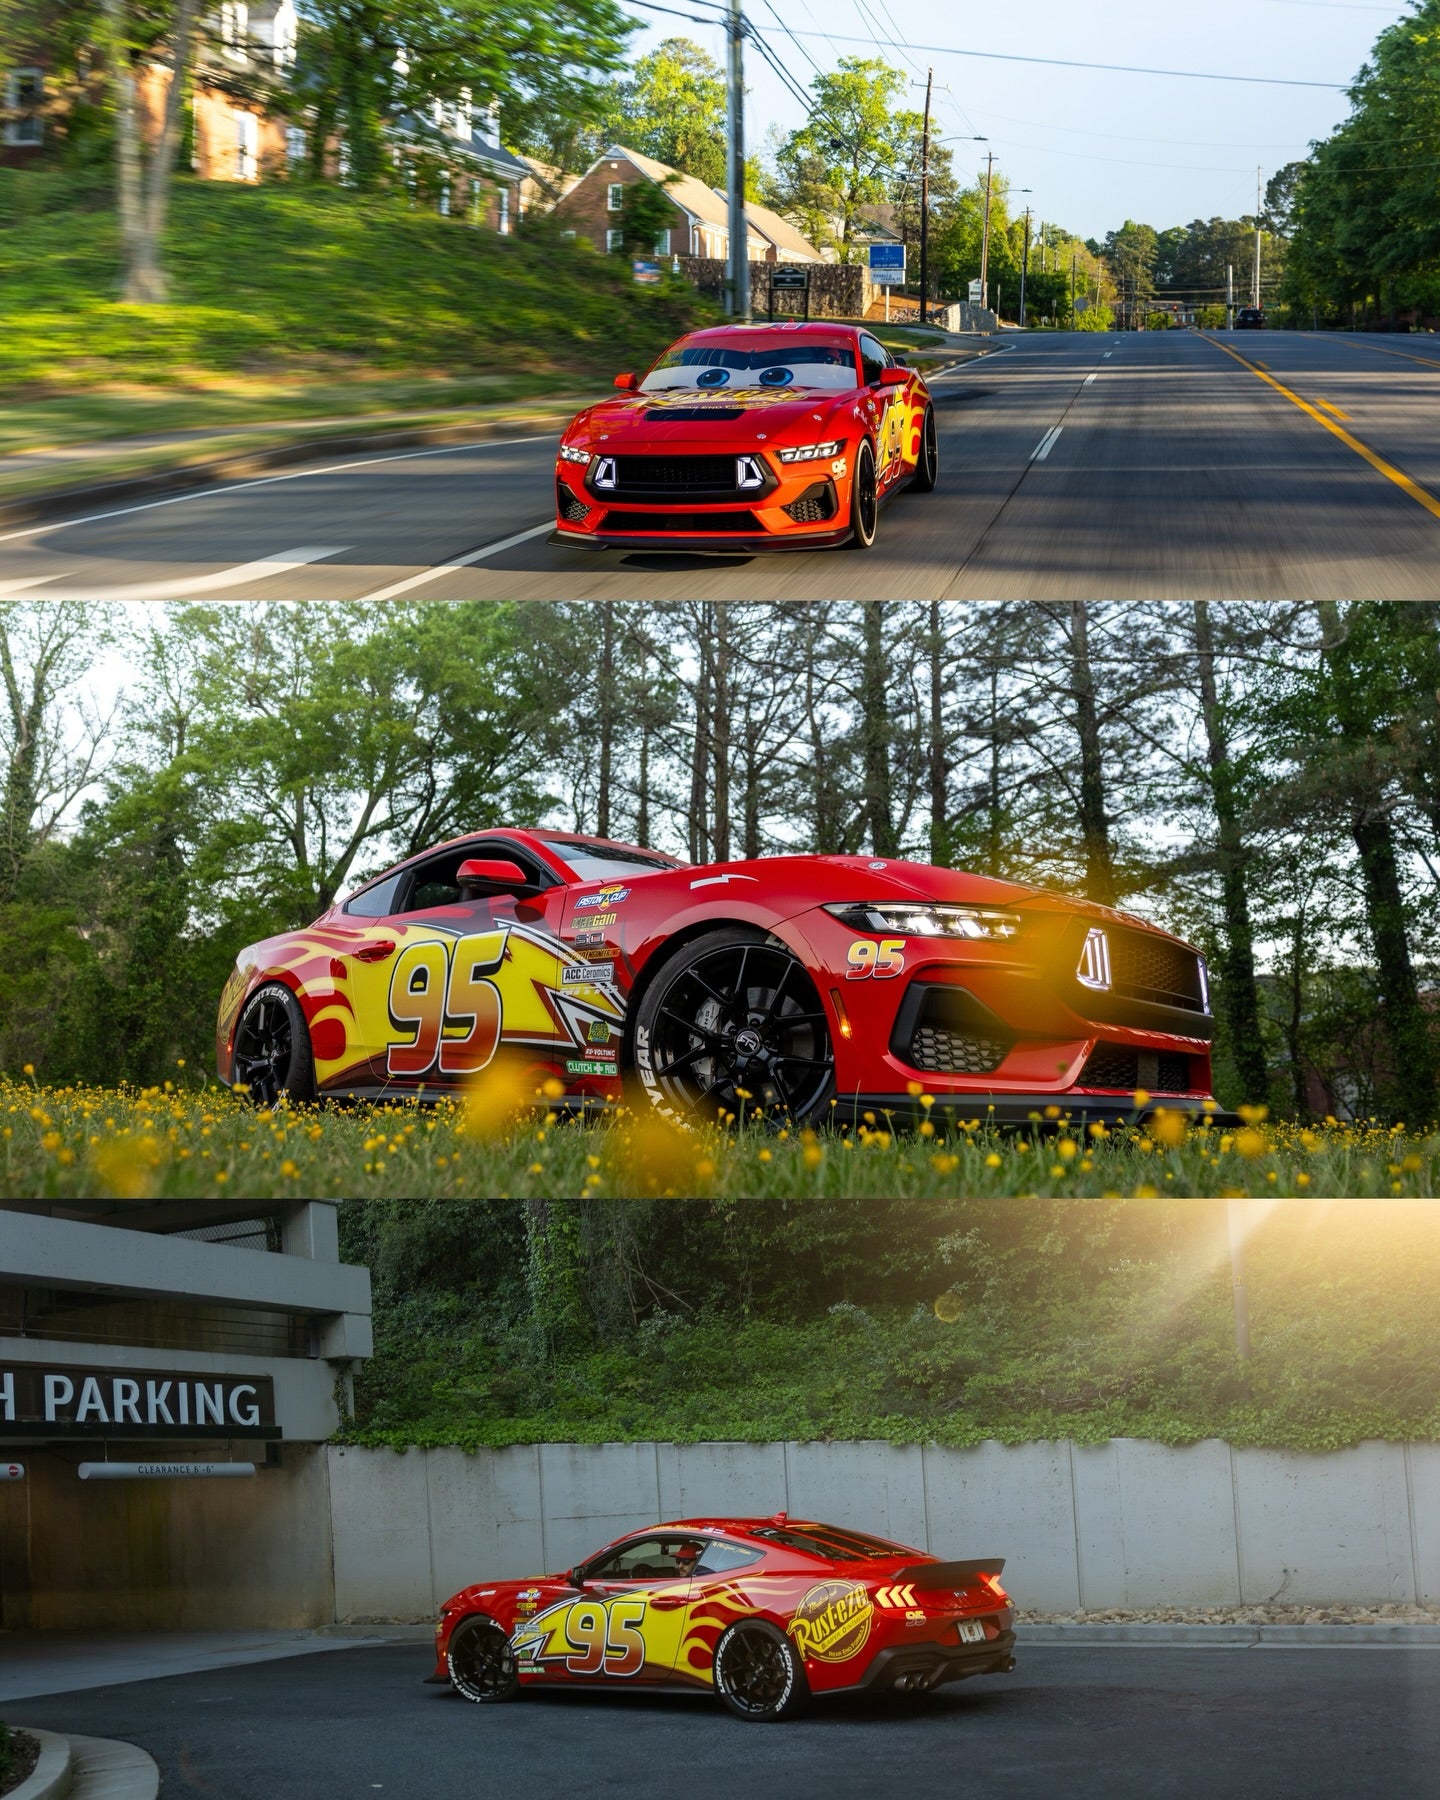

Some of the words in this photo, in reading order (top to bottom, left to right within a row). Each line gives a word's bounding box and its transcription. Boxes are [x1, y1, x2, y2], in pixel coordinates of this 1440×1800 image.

[831, 458, 847, 480] 95
[610, 891, 627, 902] CUP
[564, 969, 581, 980] ACC
[582, 965, 611, 979] Ceramics
[846, 939, 906, 980] 95
[243, 987, 289, 1021] LIGHTYEAR
[387, 926, 512, 1075] 95
[568, 1062, 593, 1073] CLUTCH
[604, 1064, 616, 1074] AID
[44, 1374, 260, 1426] PARKING
[138, 1465, 190, 1474] CLEARANCE
[905, 1610, 927, 1627] 95
[565, 1602, 646, 1677] 95
[776, 1643, 793, 1712] LIGHTYEAR
